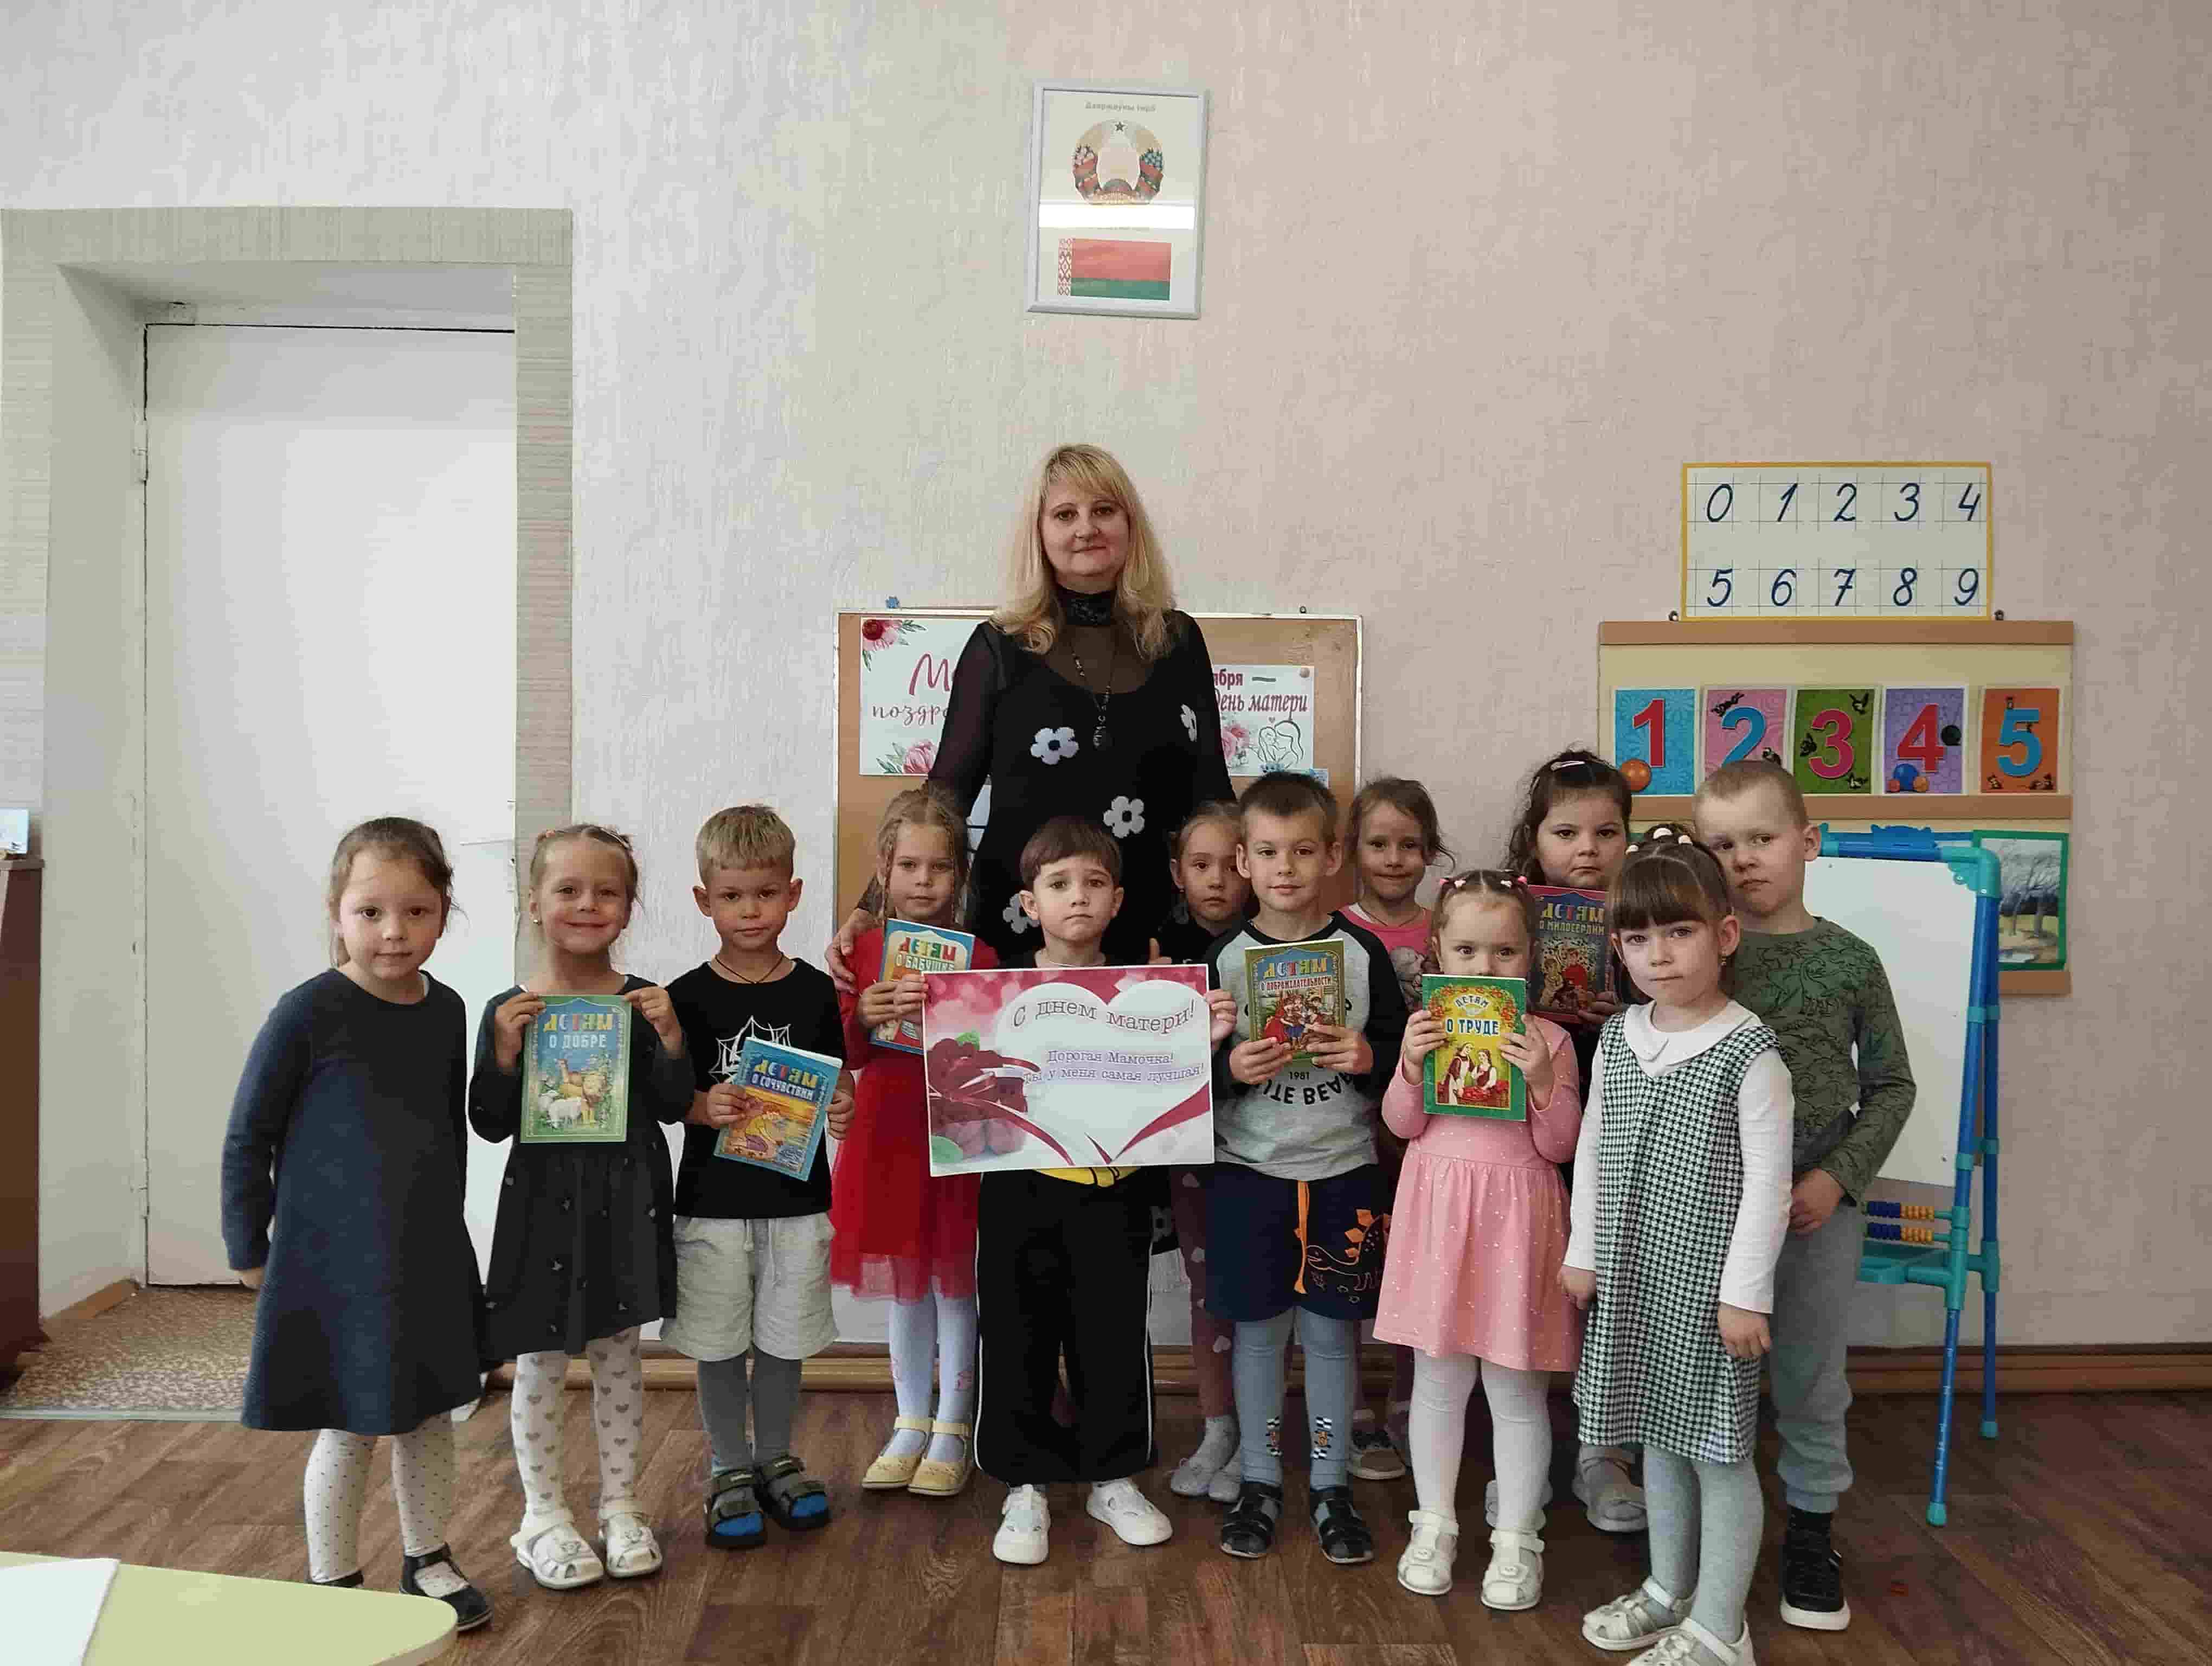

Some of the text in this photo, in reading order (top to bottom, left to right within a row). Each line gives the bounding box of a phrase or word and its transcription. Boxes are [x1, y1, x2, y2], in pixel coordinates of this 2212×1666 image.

[1707, 483, 1980, 522] 0 1 2 3 4
[1707, 567, 1979, 606] 5 6 7 8 9
[1248, 694, 1308, 721] матери
[1633, 699, 1664, 767] 1
[1722, 707, 1766, 767] 2
[1809, 709, 1854, 778] 3
[1897, 703, 1945, 772] 4
[1997, 708, 2042, 777] 5
[1014, 1006, 1026, 1027] С
[1107, 999, 1194, 1034] матери!
[1447, 1019, 1499, 1036] О ТРУДЕ
[549, 1034, 608, 1050] О ДОБРЕ
[1047, 1050, 1174, 1065] Дорогая Мамочка!
[1049, 1069, 1057, 1081] у
[1061, 1068, 1096, 1078] меня
[1102, 1069, 1142, 1081] самая
[1147, 1063, 1204, 1084] лучшая!
